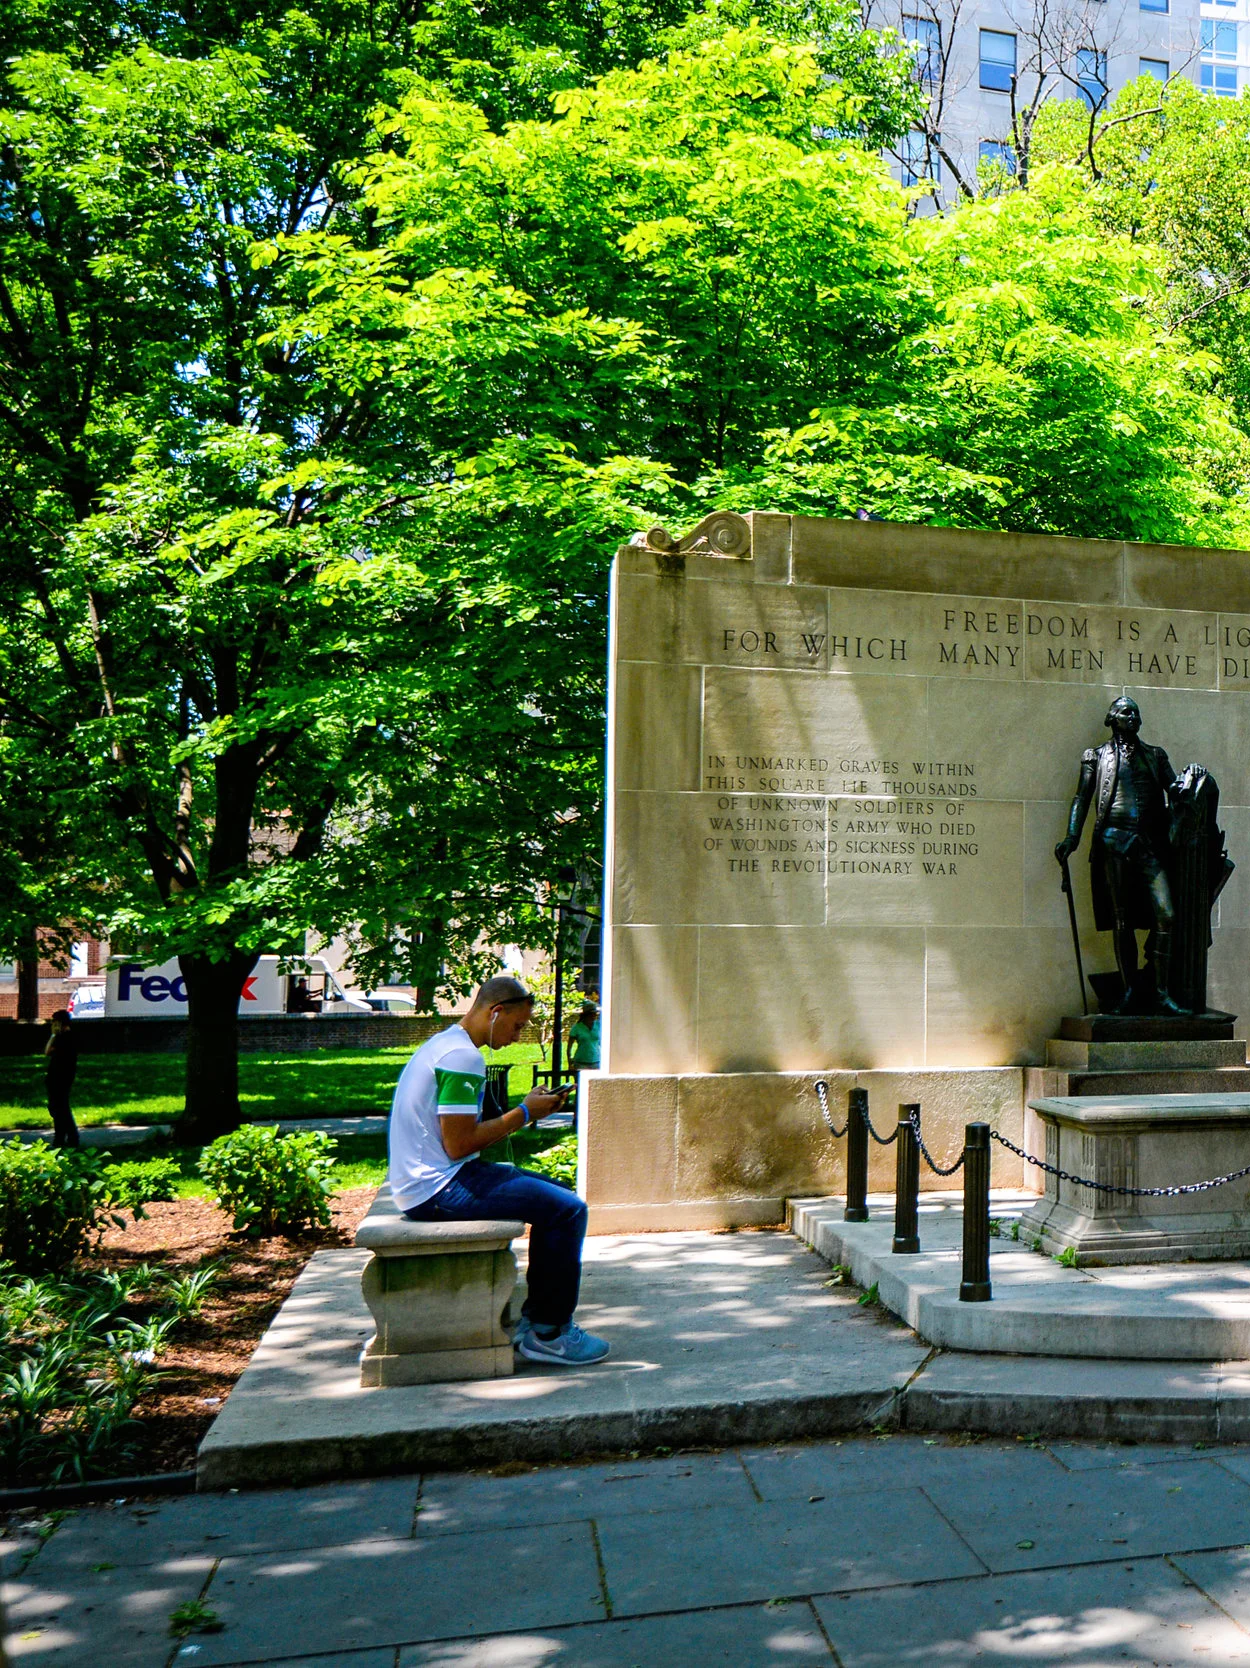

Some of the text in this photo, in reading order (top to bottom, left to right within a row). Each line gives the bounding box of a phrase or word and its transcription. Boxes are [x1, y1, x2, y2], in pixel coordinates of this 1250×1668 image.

[944, 610, 1088, 638] FREEDOM
[1117, 621, 1140, 641] IS
[1164, 624, 1178, 643] A
[723, 629, 780, 653] FOR
[801, 634, 907, 661] WHICH
[939, 642, 1020, 667] MANY
[1047, 648, 1104, 670] MEN
[1128, 653, 1197, 675] HAVE
[708, 755, 974, 776] IN UNMARKED GRAVES WITHIN
[706, 776, 977, 796] THIS SQUARE LIE THOUSANDS
[718, 797, 965, 816] OF UNKNOWN SOLDIERS OF
[710, 818, 975, 835] WASHINGTON'S ARMY WHO DIED
[704, 838, 978, 856] OF WOUNDS AND SICKNESS DURING
[728, 859, 958, 875] THE REVOLUTIONARY WAR
